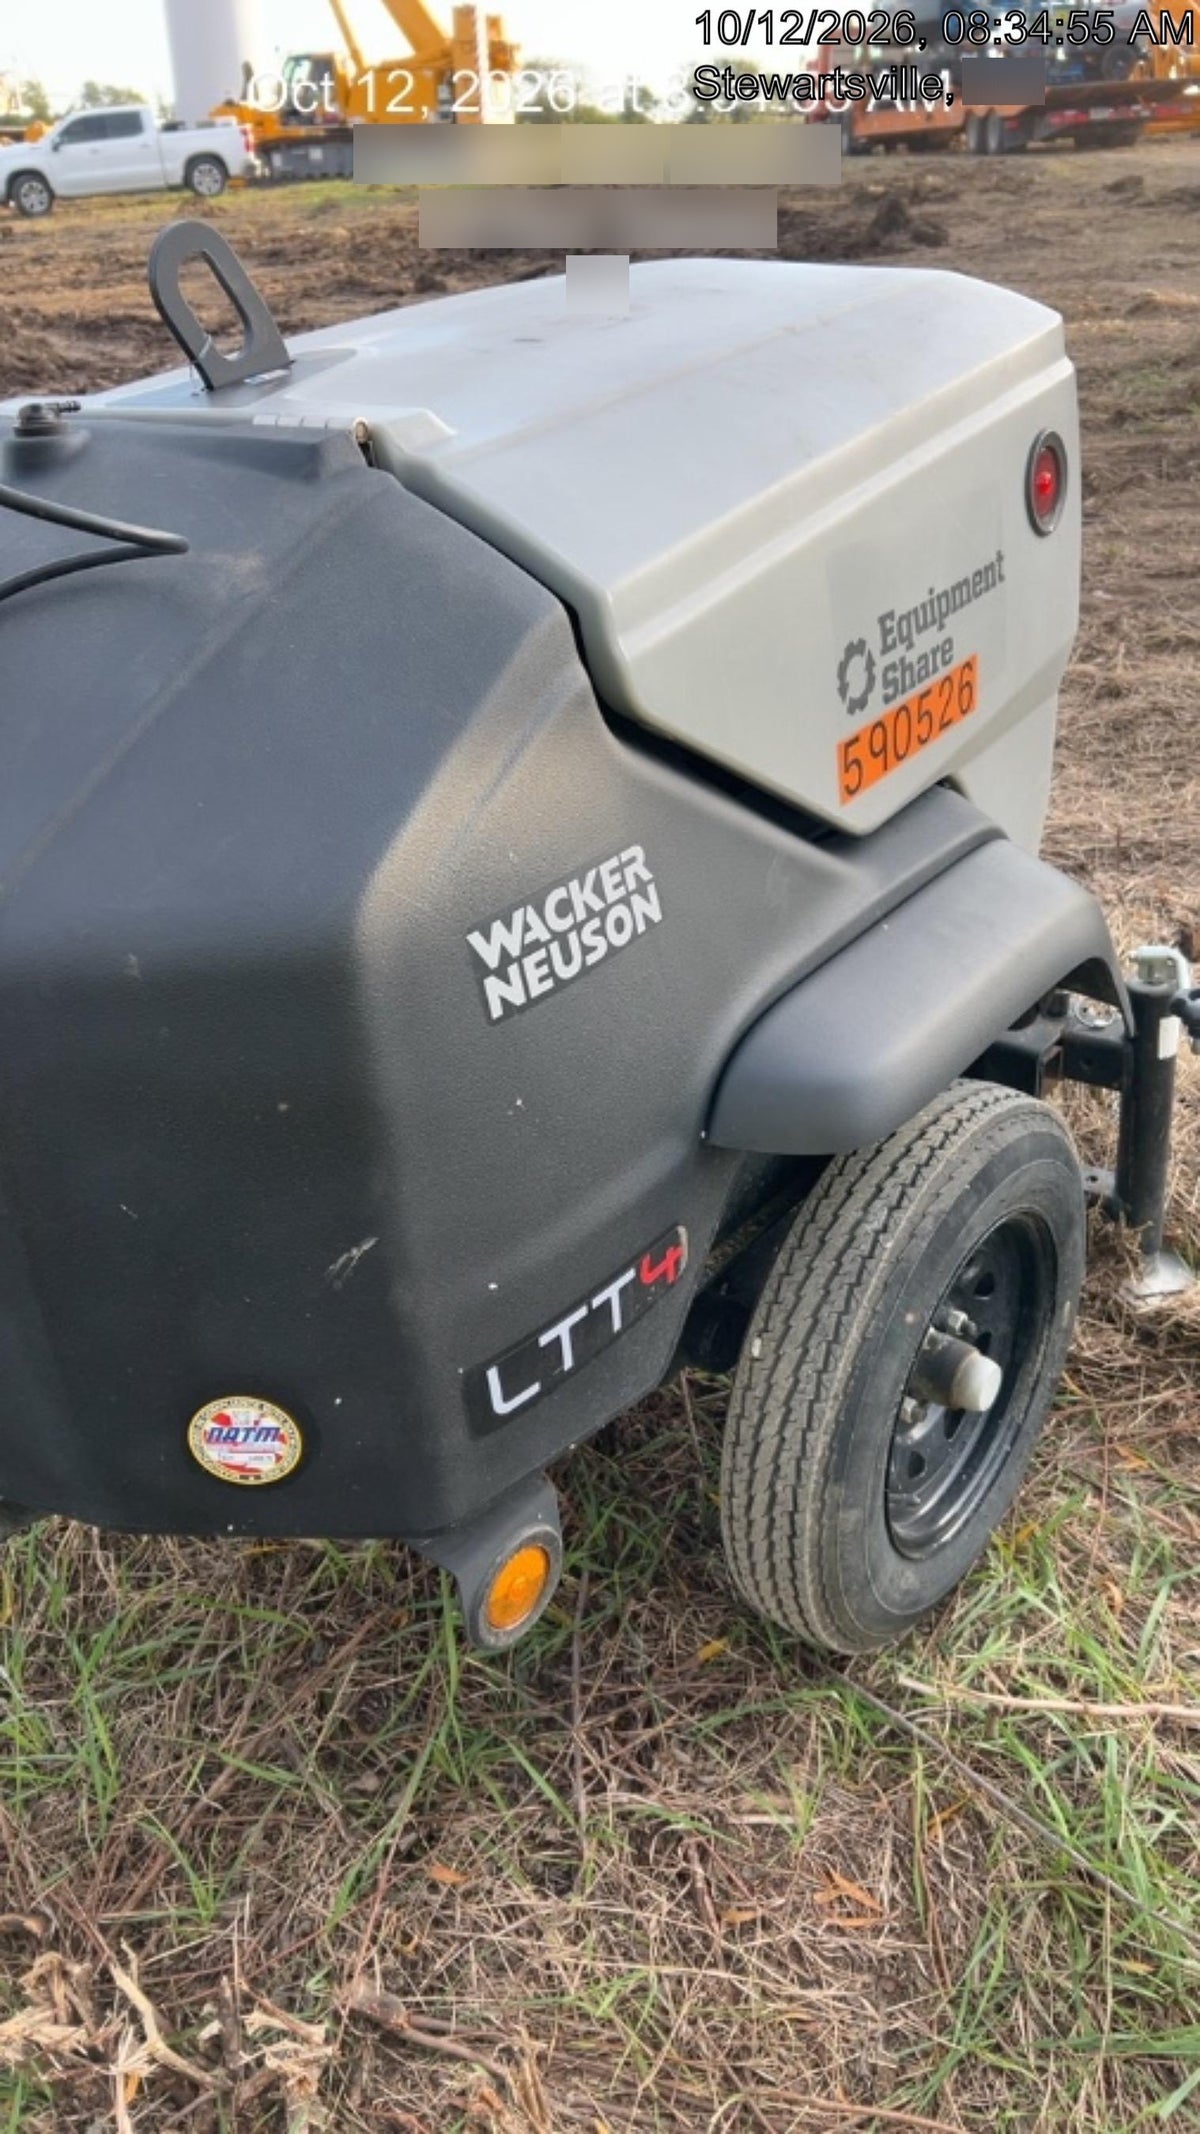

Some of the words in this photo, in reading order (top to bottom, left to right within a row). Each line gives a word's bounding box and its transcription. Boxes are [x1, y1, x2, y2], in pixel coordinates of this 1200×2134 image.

[877, 549, 1006, 656] Equipment
[842, 660, 975, 797] 590526
[881, 636, 954, 705] Share
[466, 844, 654, 971] WACKER
[483, 882, 663, 1021] NEUSON
[485, 1245, 684, 1415] LTT4
